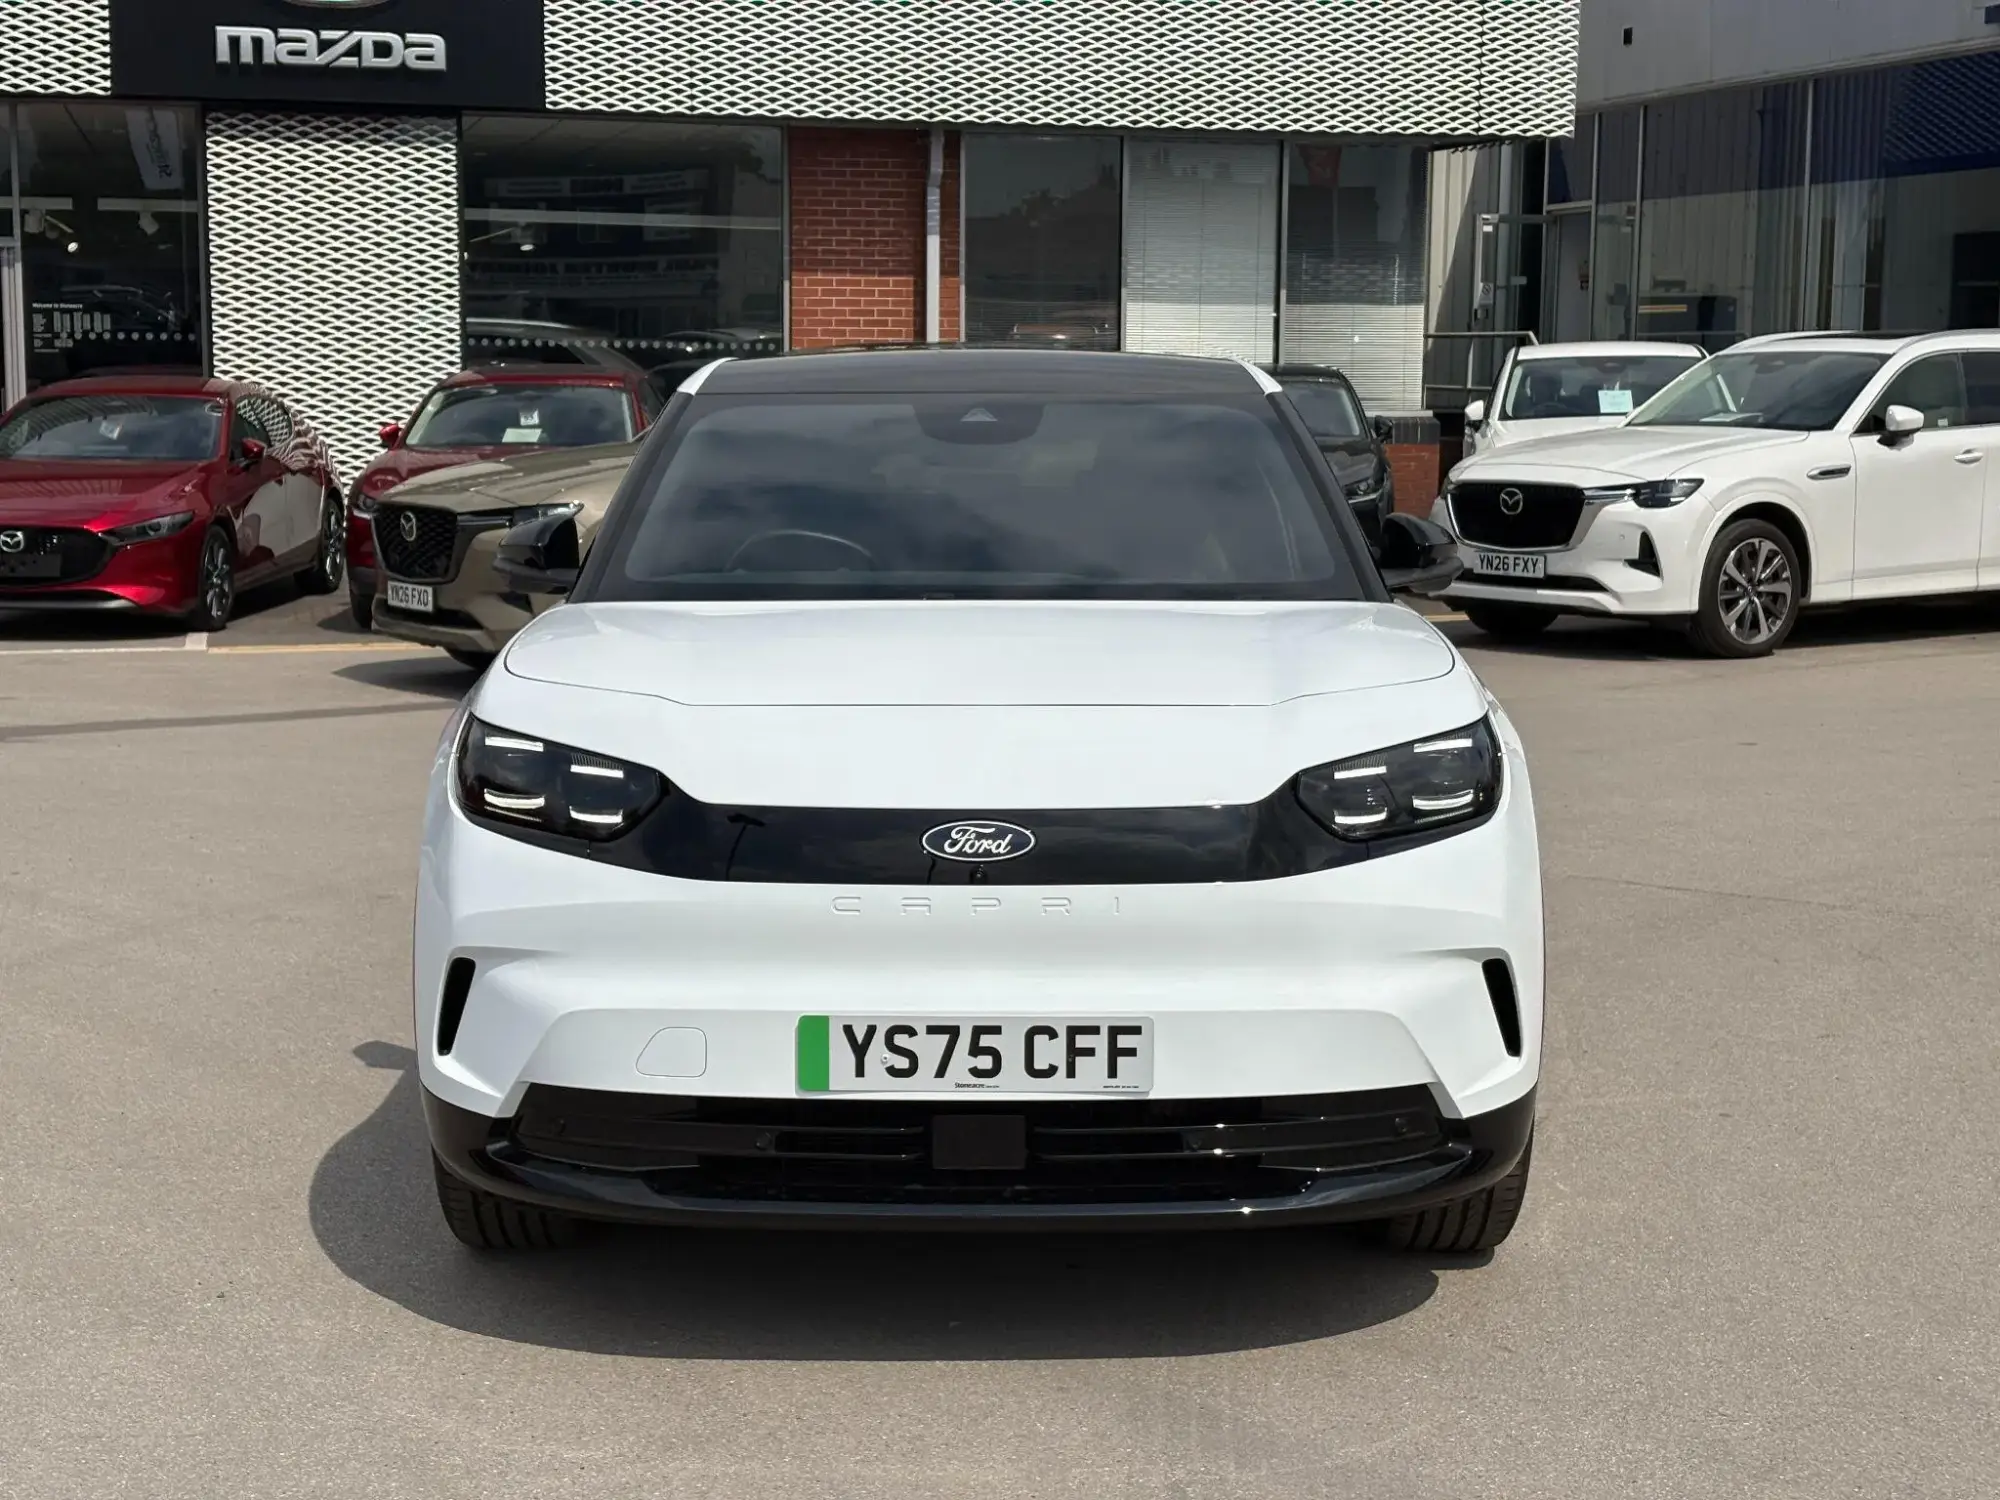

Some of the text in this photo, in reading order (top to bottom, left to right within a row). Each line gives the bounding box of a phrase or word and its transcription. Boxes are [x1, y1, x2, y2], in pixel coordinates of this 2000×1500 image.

[1479, 554, 1539, 574] YN26 FXY
[943, 826, 1013, 855] Ford
[830, 896, 1120, 916] CAPRI
[842, 1024, 1143, 1079] YS75 CFF
